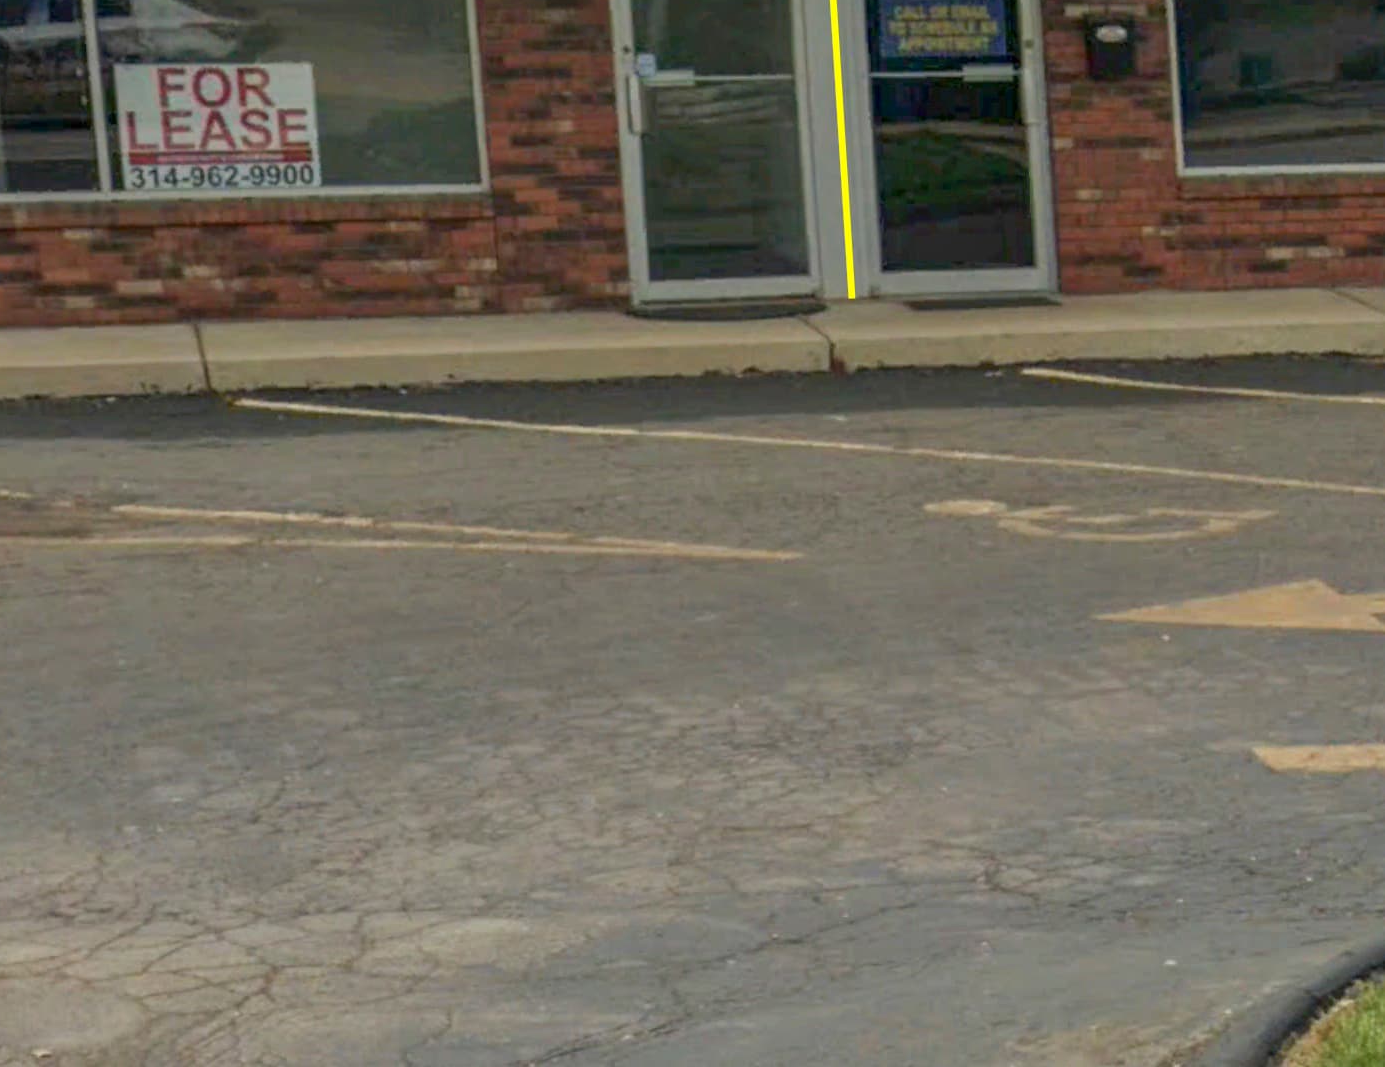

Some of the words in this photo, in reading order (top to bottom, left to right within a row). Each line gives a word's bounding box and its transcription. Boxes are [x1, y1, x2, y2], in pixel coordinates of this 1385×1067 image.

[156, 66, 276, 108] FOR
[125, 108, 311, 151] LEASE
[130, 163, 315, 189] 314-962-9900
